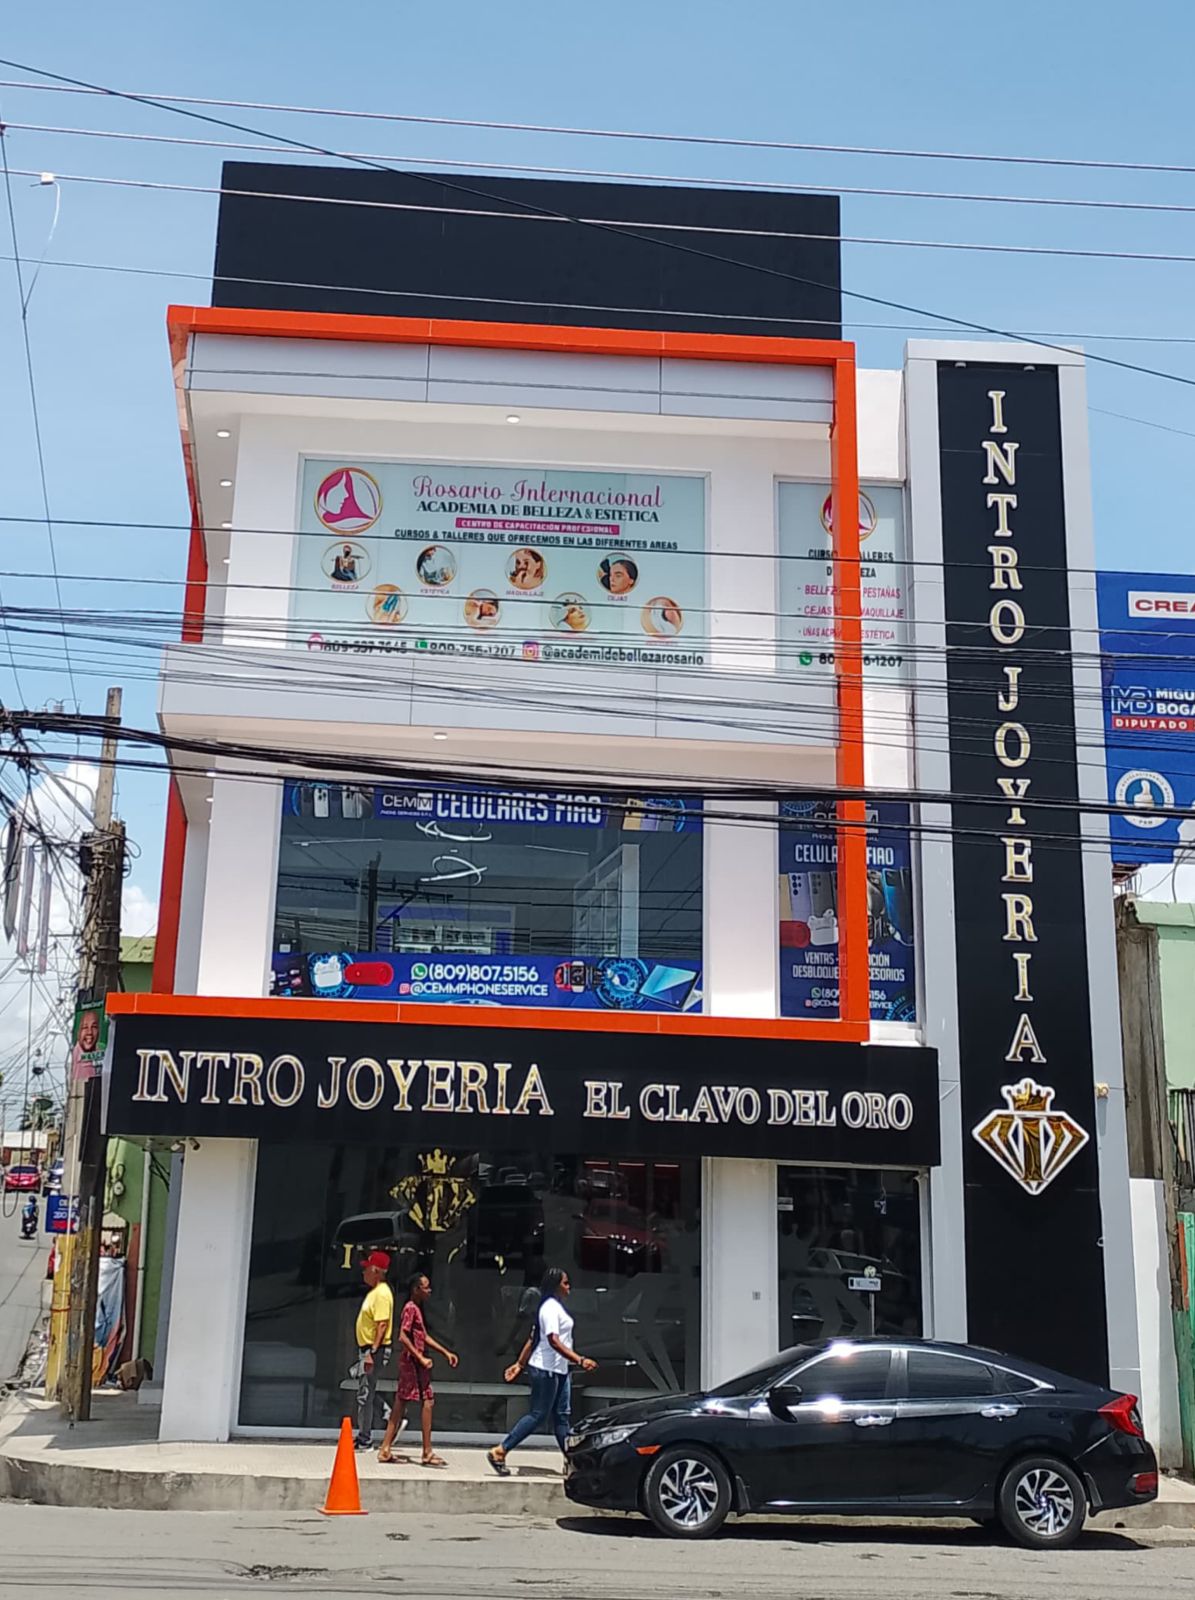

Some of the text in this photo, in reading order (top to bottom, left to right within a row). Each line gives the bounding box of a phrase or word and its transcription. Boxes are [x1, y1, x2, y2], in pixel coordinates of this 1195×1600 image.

[412, 475, 664, 508] Rosario Internacional
[416, 500, 660, 522] ACADEMIA DE BELLEZA & ESTETICA
[981, 390, 1026, 644] INTRO
[461, 520, 492, 529] CENTRO
[493, 521, 503, 529] DE
[561, 524, 613, 533] PROFESIONAL
[394, 529, 430, 539] CURSOS
[433, 530, 439, 539] &
[442, 530, 485, 541] TALLERES
[487, 533, 506, 542] QUE
[508, 533, 560, 544] OFRECEMOS
[563, 536, 575, 545] EN
[577, 537, 593, 546] LAS
[595, 538, 647, 549] DIFERENTES
[805, 585, 837, 596] BELLEZ
[804, 605, 832, 616] CEJAS
[1115, 718, 1188, 730] DIPUTADO
[795, 844, 839, 863] CELULA
[993, 666, 1047, 1063] JOYERIA
[804, 951, 835, 966] VENTAS
[429, 963, 539, 981] (809)807.5156
[793, 965, 840, 980] DESBLOQUE
[869, 967, 906, 982] ESORIOS
[411, 981, 549, 997] @CEMMPHONESERVICE
[132, 1049, 913, 1131] INTRO JOYERIA EL CLAVO DEL ORO
